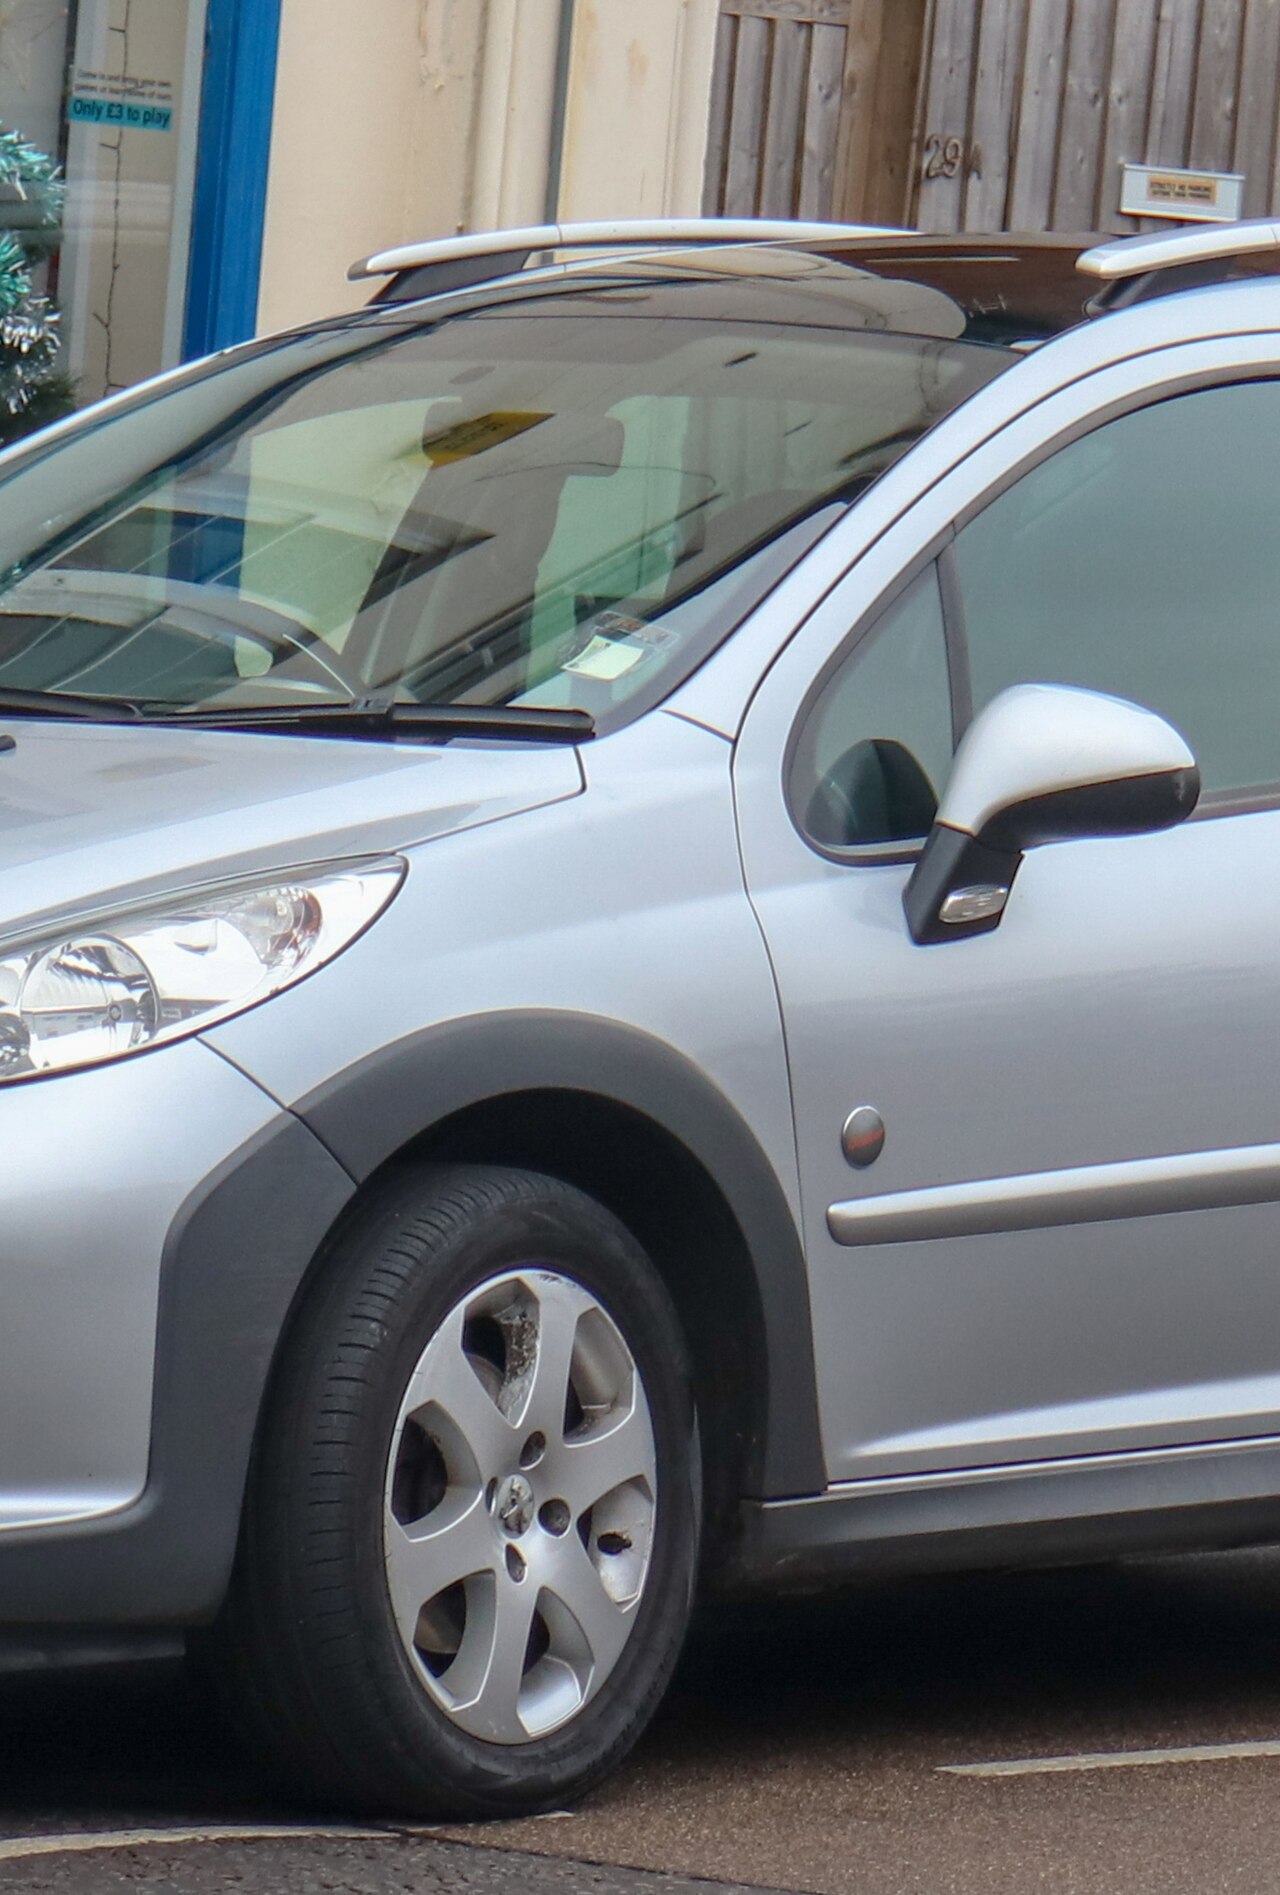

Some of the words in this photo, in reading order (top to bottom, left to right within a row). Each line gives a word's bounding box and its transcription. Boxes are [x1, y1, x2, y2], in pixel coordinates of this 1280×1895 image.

[73, 99, 102, 121] Only
[107, 103, 123, 120] £3
[127, 106, 140, 121] to
[143, 107, 171, 129] play
